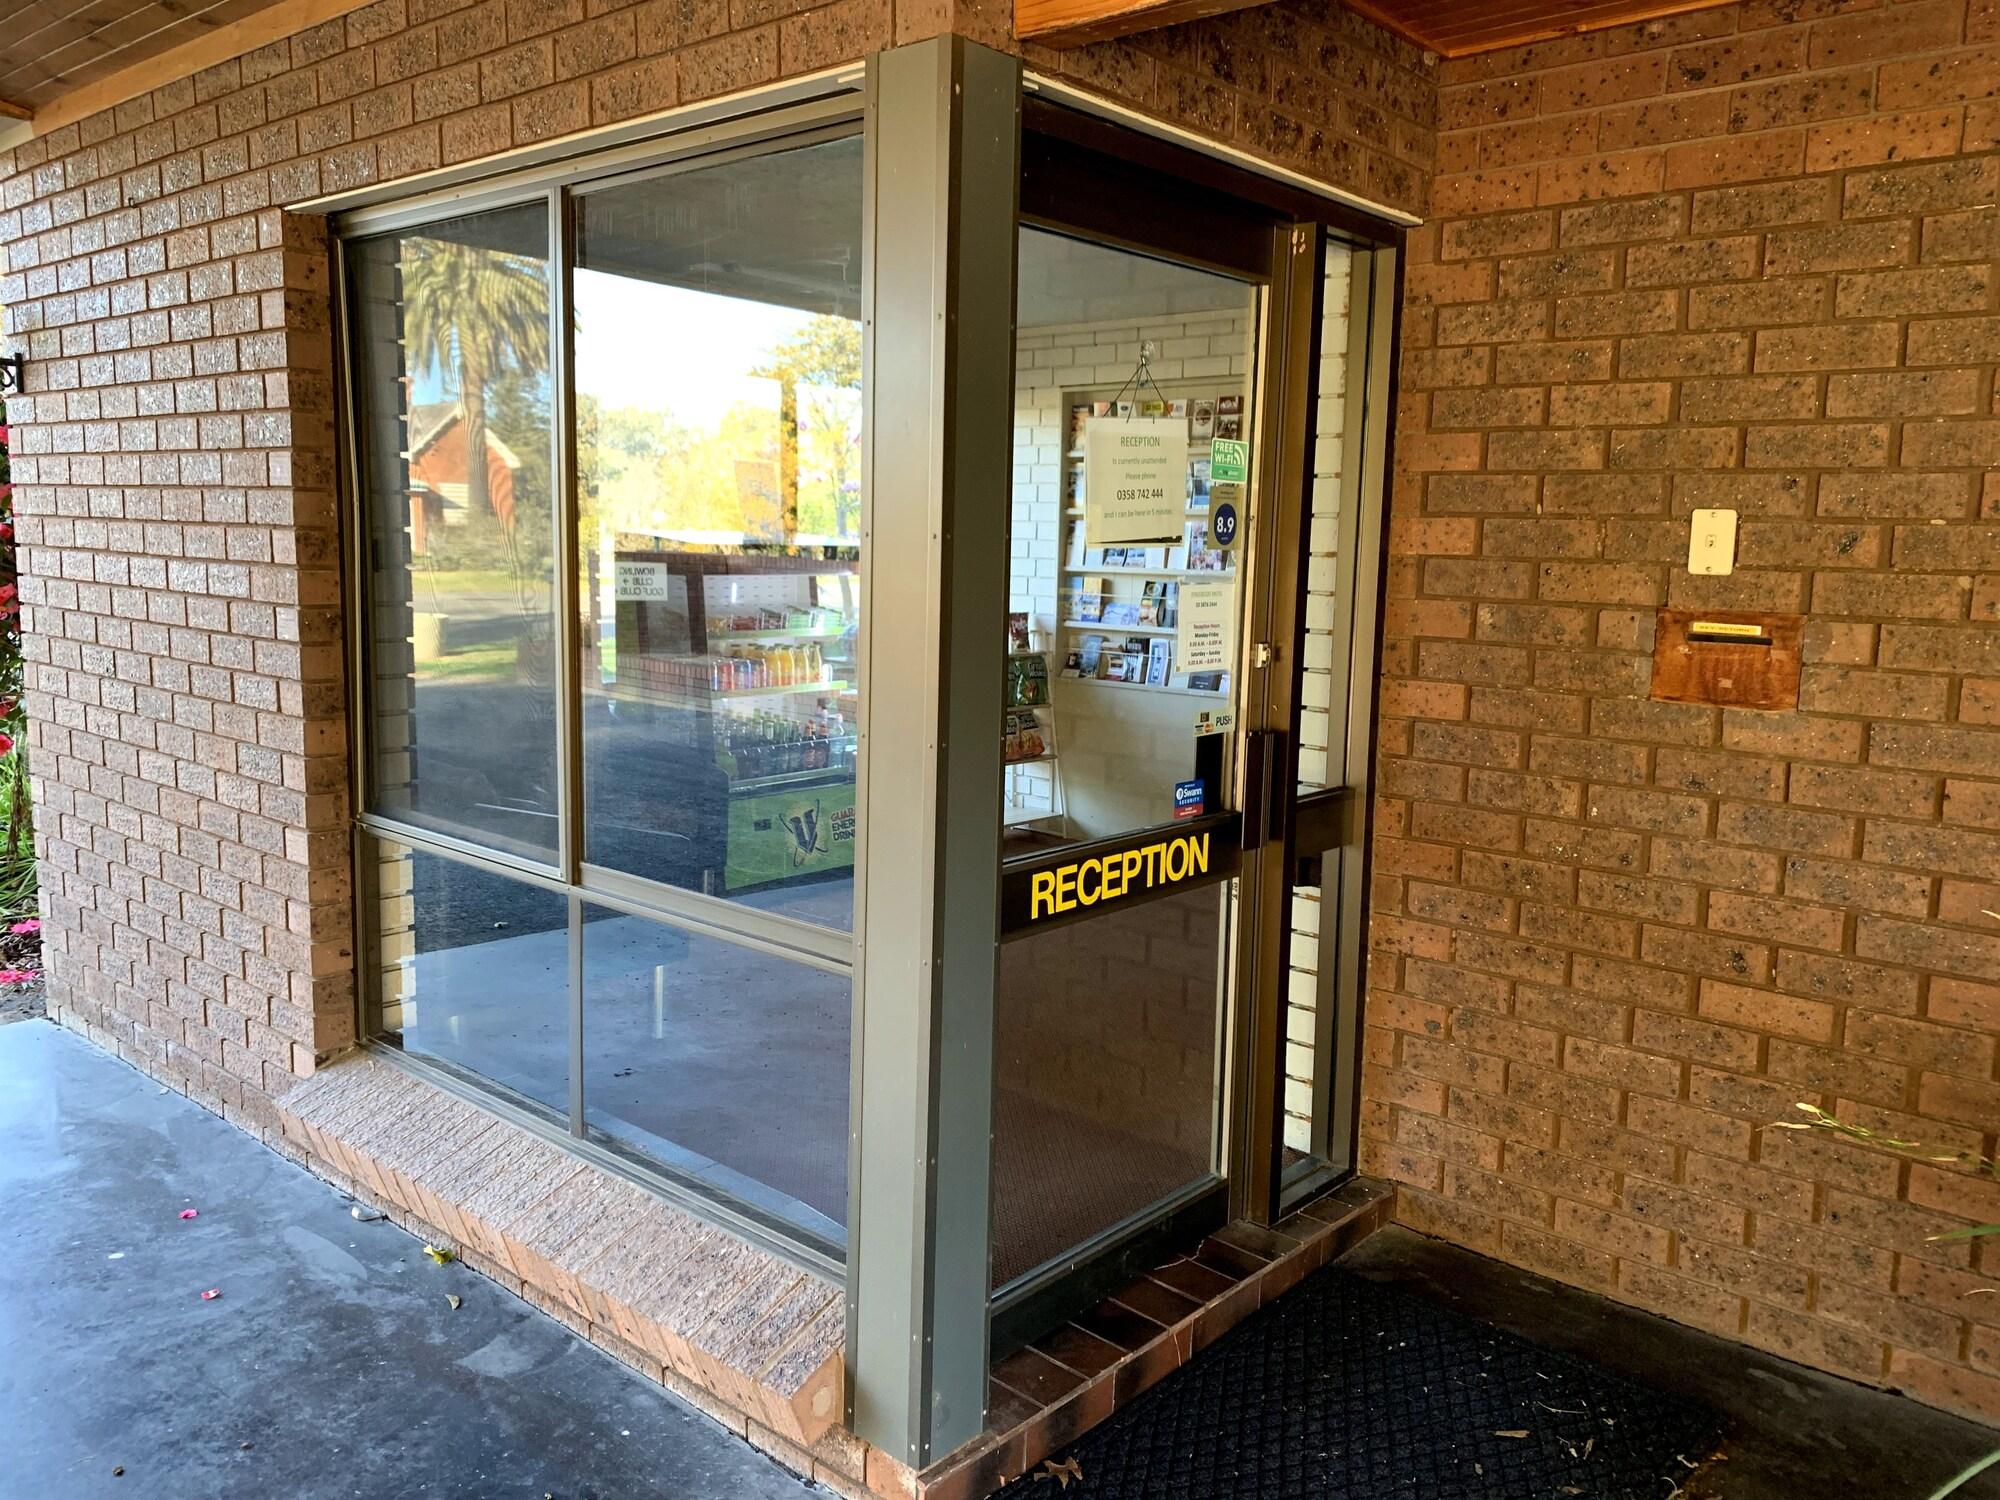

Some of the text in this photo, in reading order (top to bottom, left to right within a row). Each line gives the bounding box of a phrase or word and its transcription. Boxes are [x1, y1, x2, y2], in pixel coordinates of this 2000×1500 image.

[1120, 436, 1160, 447] RECEPTION
[1215, 442, 1234, 453] FREE
[1215, 453, 1234, 465] WI-FI
[1116, 488, 1164, 500] 0358 742 444
[1216, 516, 1235, 533] 8.9
[1215, 715, 1232, 727] PUSH
[1183, 788, 1202, 798] Swann
[831, 807, 855, 822] GUAR
[831, 818, 855, 832] ENER
[833, 829, 855, 842] DRIN
[1031, 833, 1209, 920] RECEPTION
